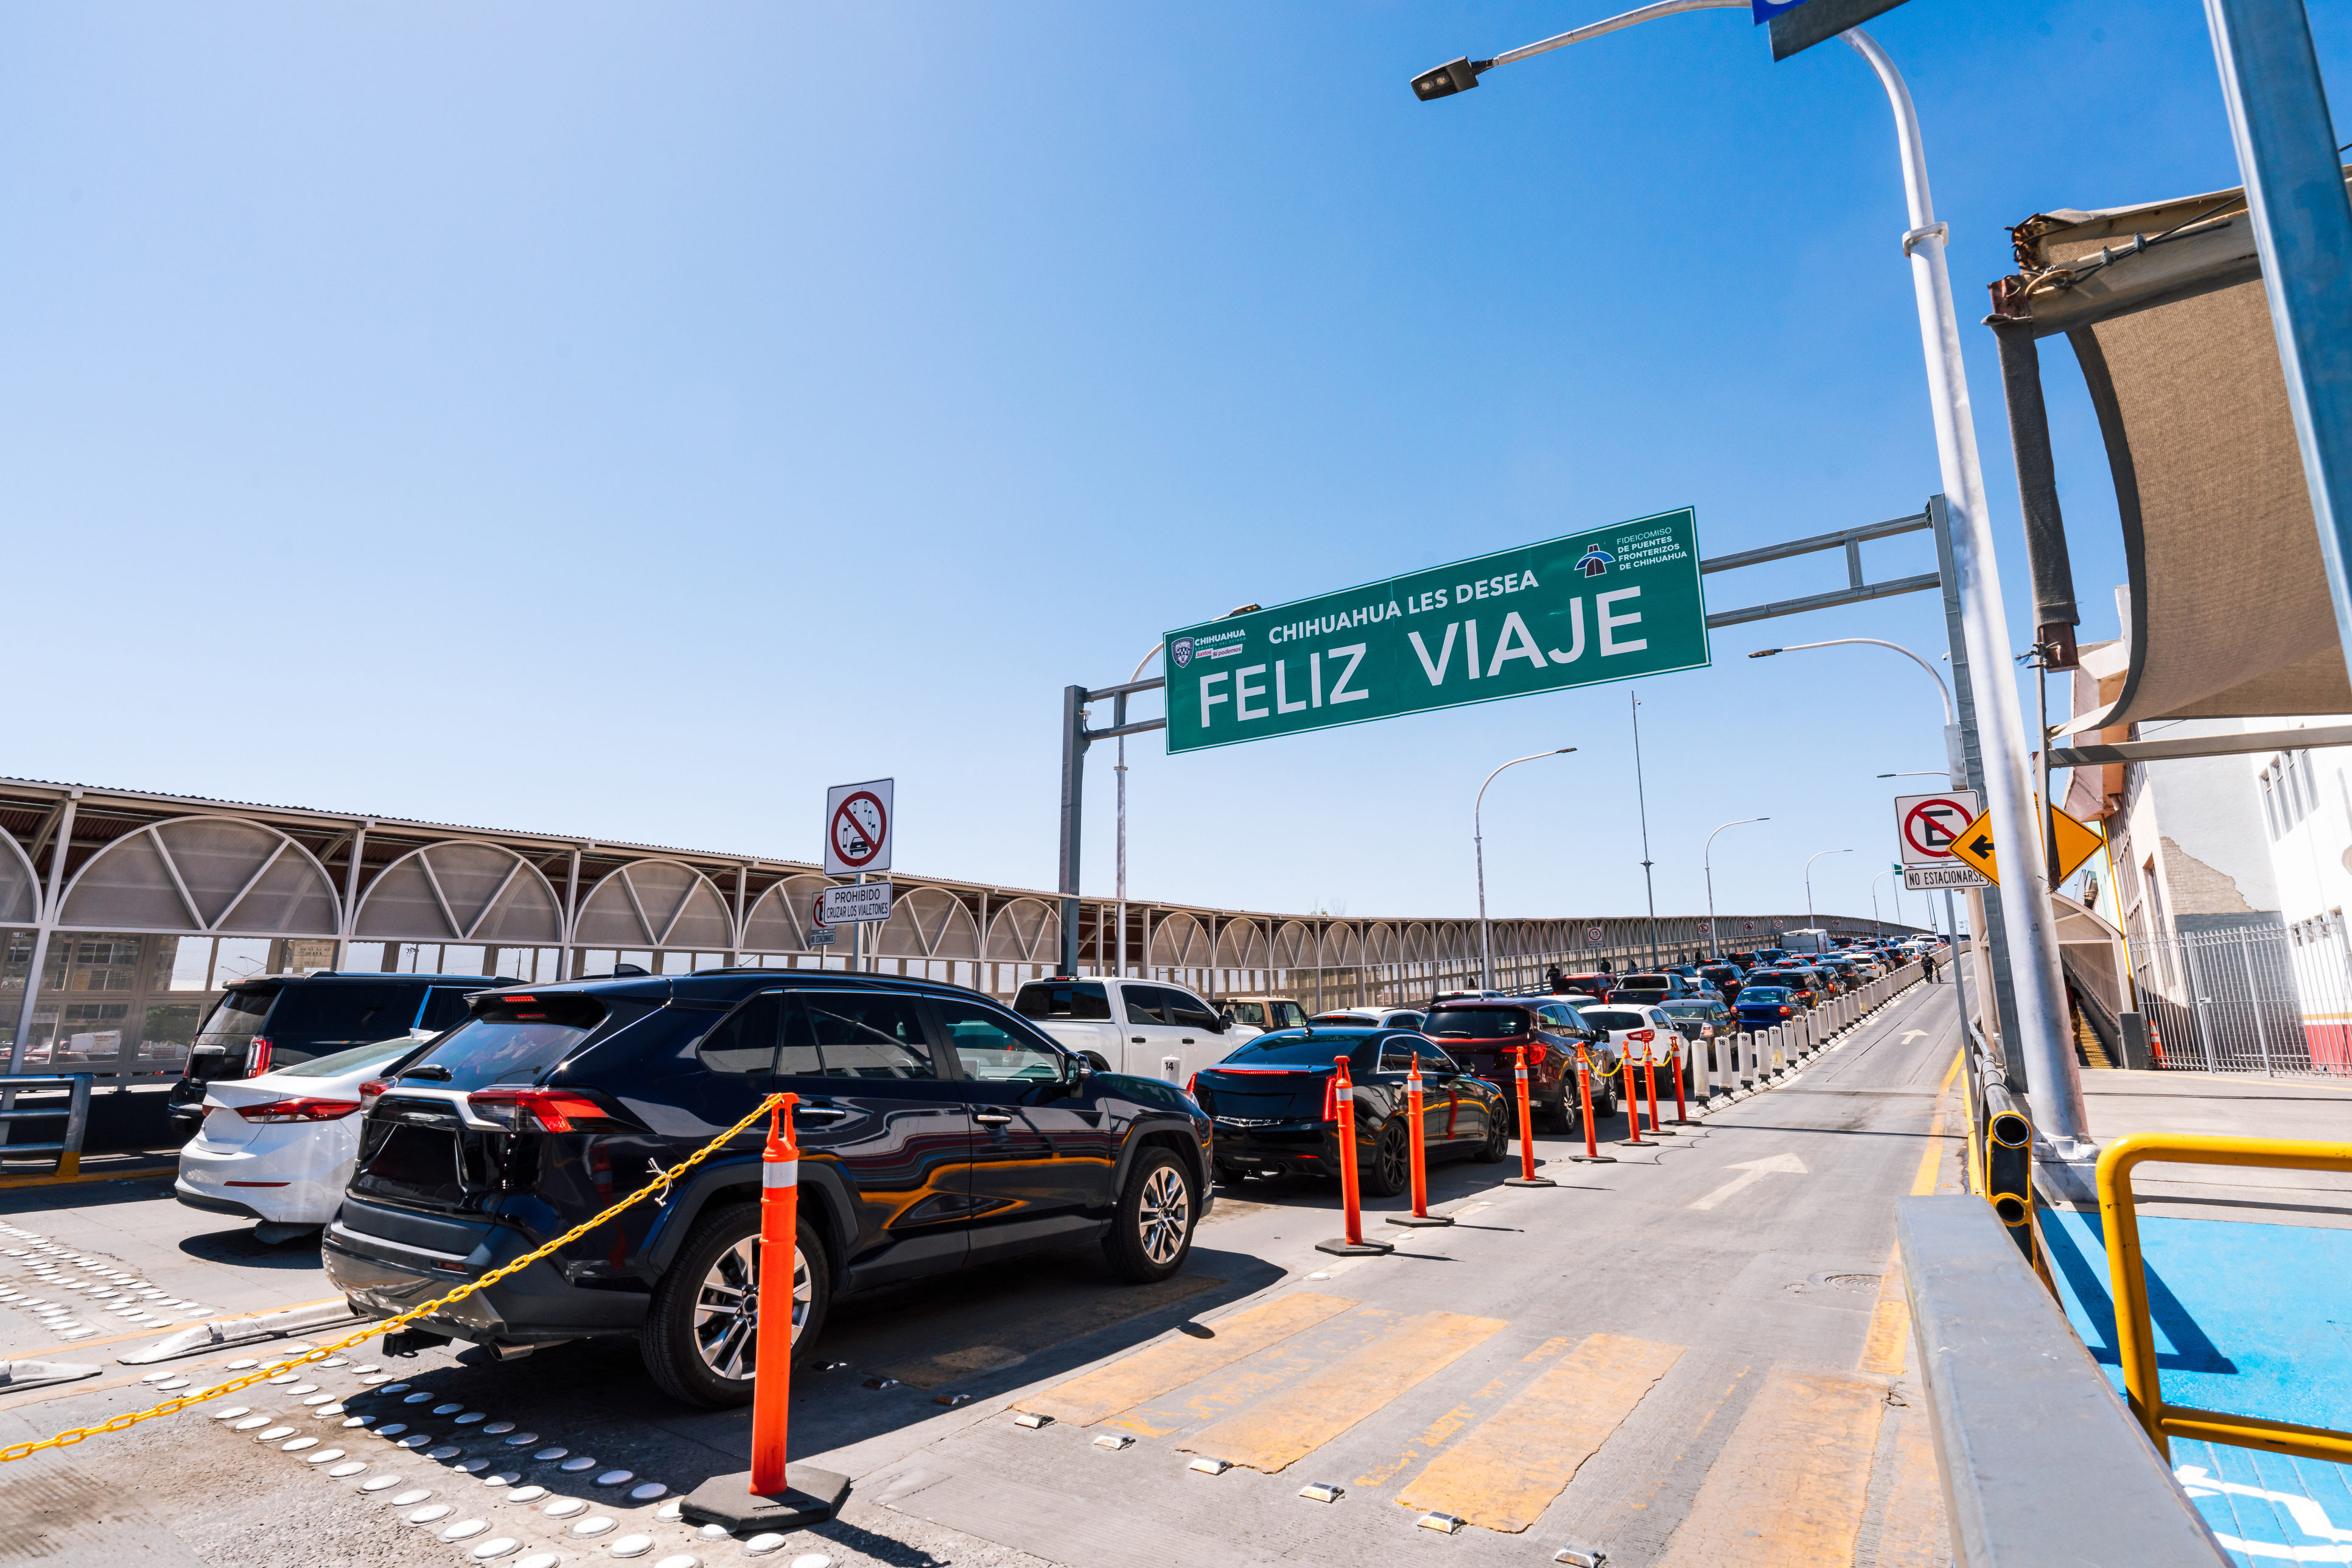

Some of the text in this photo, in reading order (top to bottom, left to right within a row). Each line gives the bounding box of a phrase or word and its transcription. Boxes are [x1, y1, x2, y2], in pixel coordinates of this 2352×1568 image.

[1617, 527, 1672, 545] FIDEICOMISO
[1631, 536, 1673, 551] PUENTES
[1619, 543, 1680, 562] FRONTERIZOS
[1619, 551, 1687, 571] DE CHIHUAHUA
[1269, 570, 1539, 644] CHIHUAHUA LES DESEA
[1194, 629, 1246, 646] CHIHUAHUA
[1200, 586, 1648, 728] FELIZ VIAJE
[1218, 646, 1242, 657] podemos
[1909, 870, 1984, 886] NO ESTACIONARSE
[835, 888, 880, 903] PROHIBIDO
[827, 906, 847, 919] CRUZAR
[847, 905, 857, 917] LOS
[858, 902, 888, 916] VIALETONES
[1164, 1062, 1174, 1071] 14
